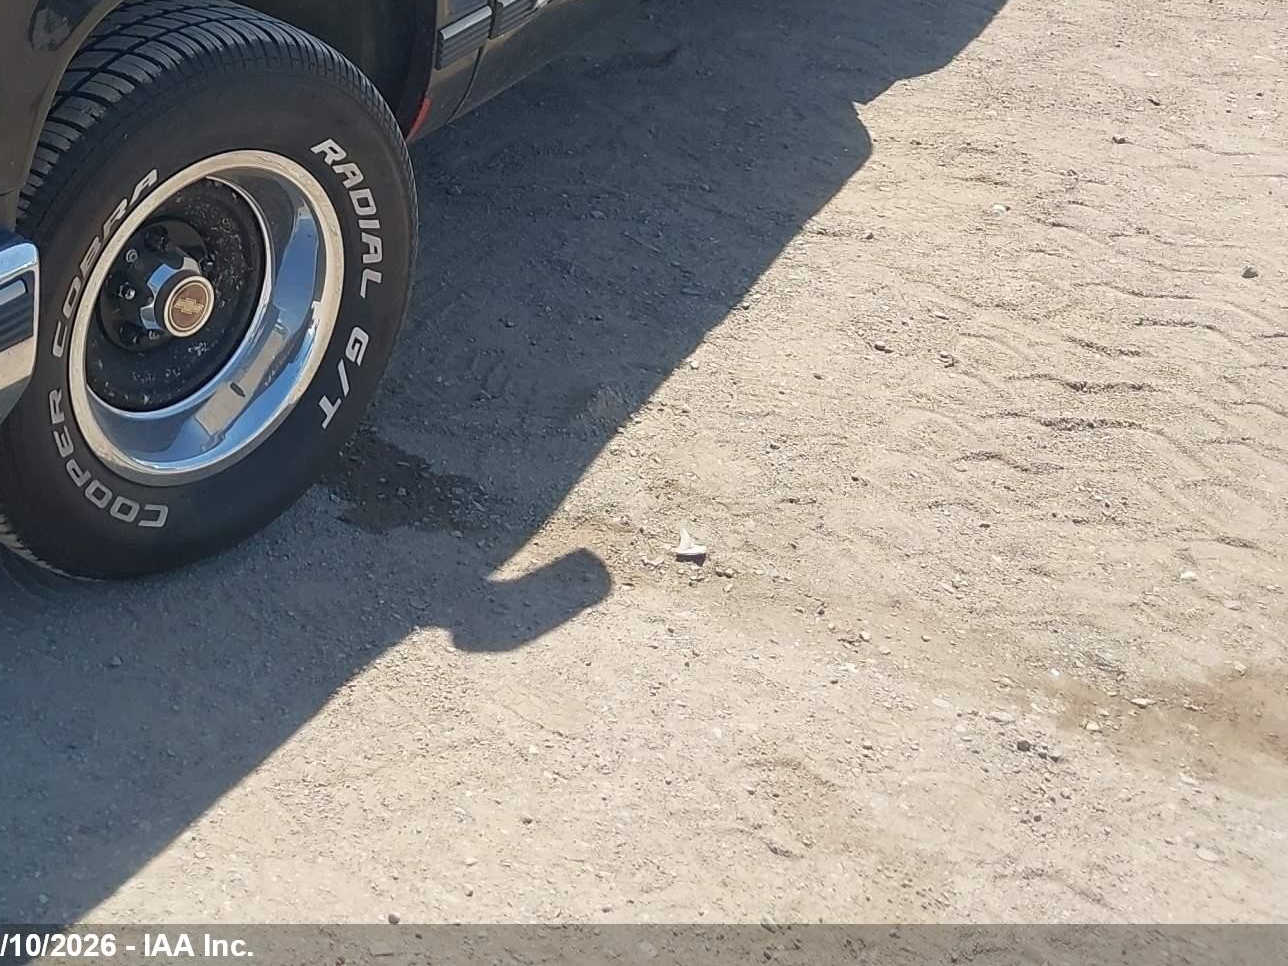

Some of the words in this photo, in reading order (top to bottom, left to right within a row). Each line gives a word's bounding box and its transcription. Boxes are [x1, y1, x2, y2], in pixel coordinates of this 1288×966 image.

[52, 169, 159, 358] COBRA
[310, 138, 384, 299] RADIAL
[318, 326, 370, 429] G/T
[48, 389, 169, 528] COOPER
